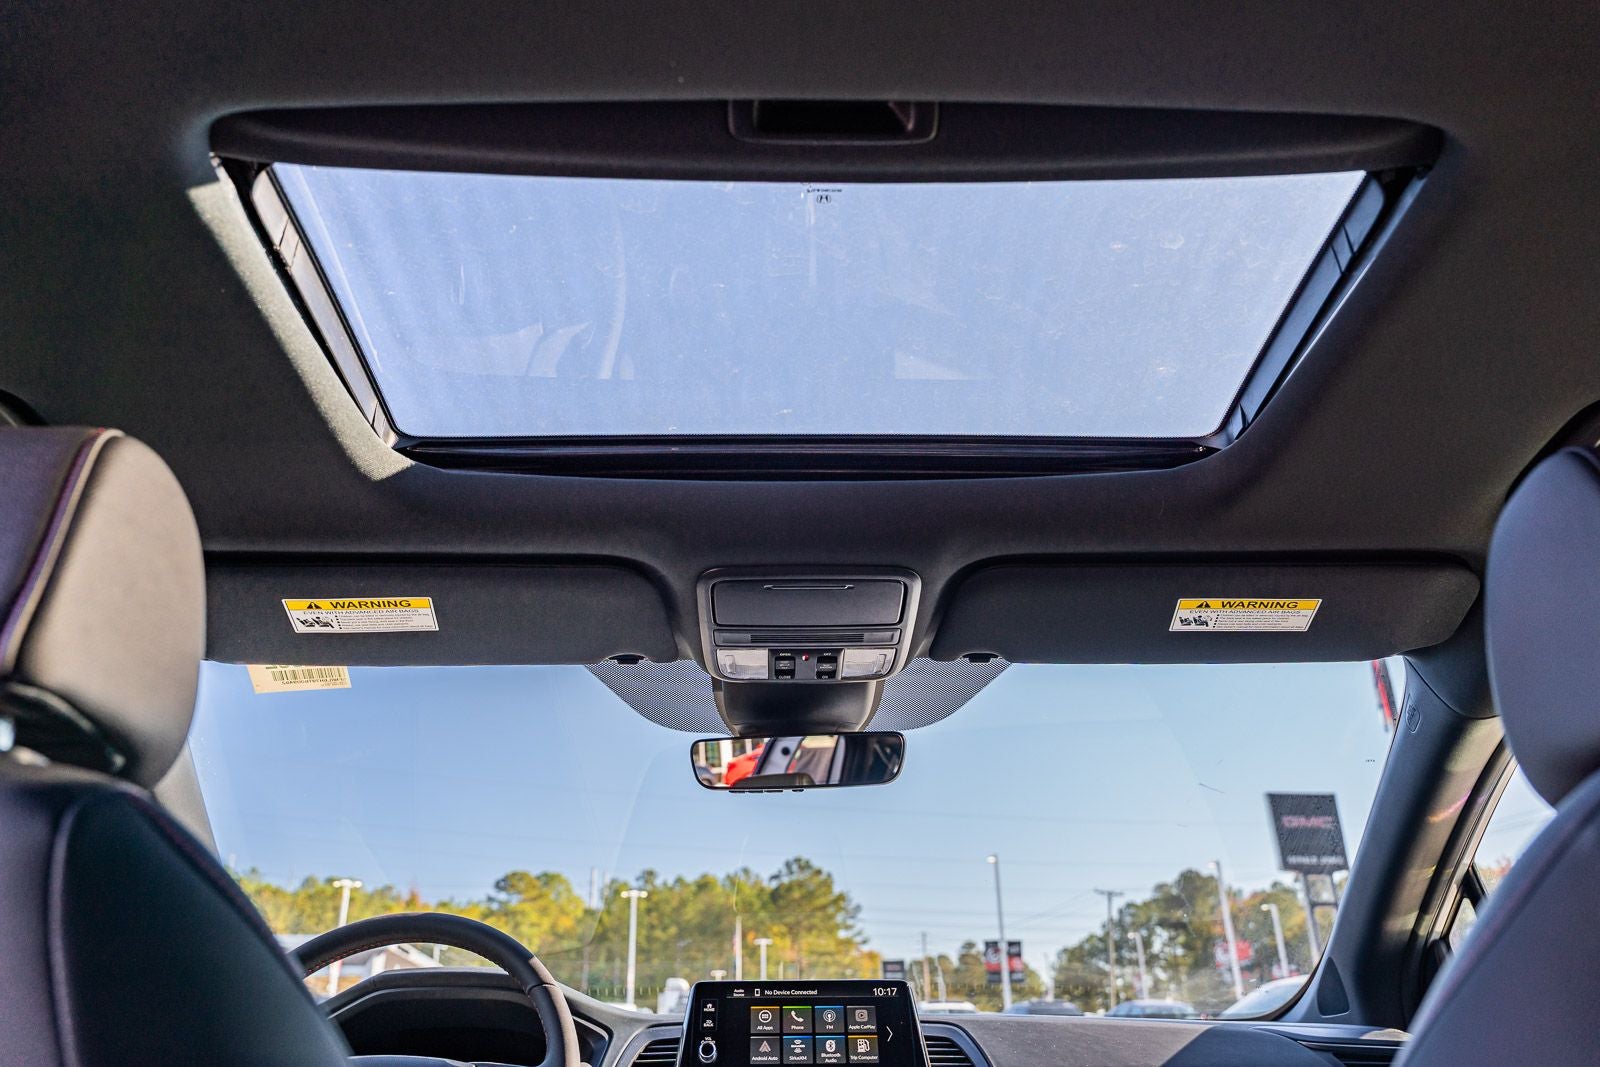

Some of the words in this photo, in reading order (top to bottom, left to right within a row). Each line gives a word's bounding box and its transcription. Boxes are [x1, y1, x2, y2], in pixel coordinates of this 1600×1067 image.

[330, 600, 411, 609] WARNING
[1221, 601, 1299, 609] WARNING
[1281, 816, 1335, 829] GMC
[872, 987, 897, 996] 10:17
